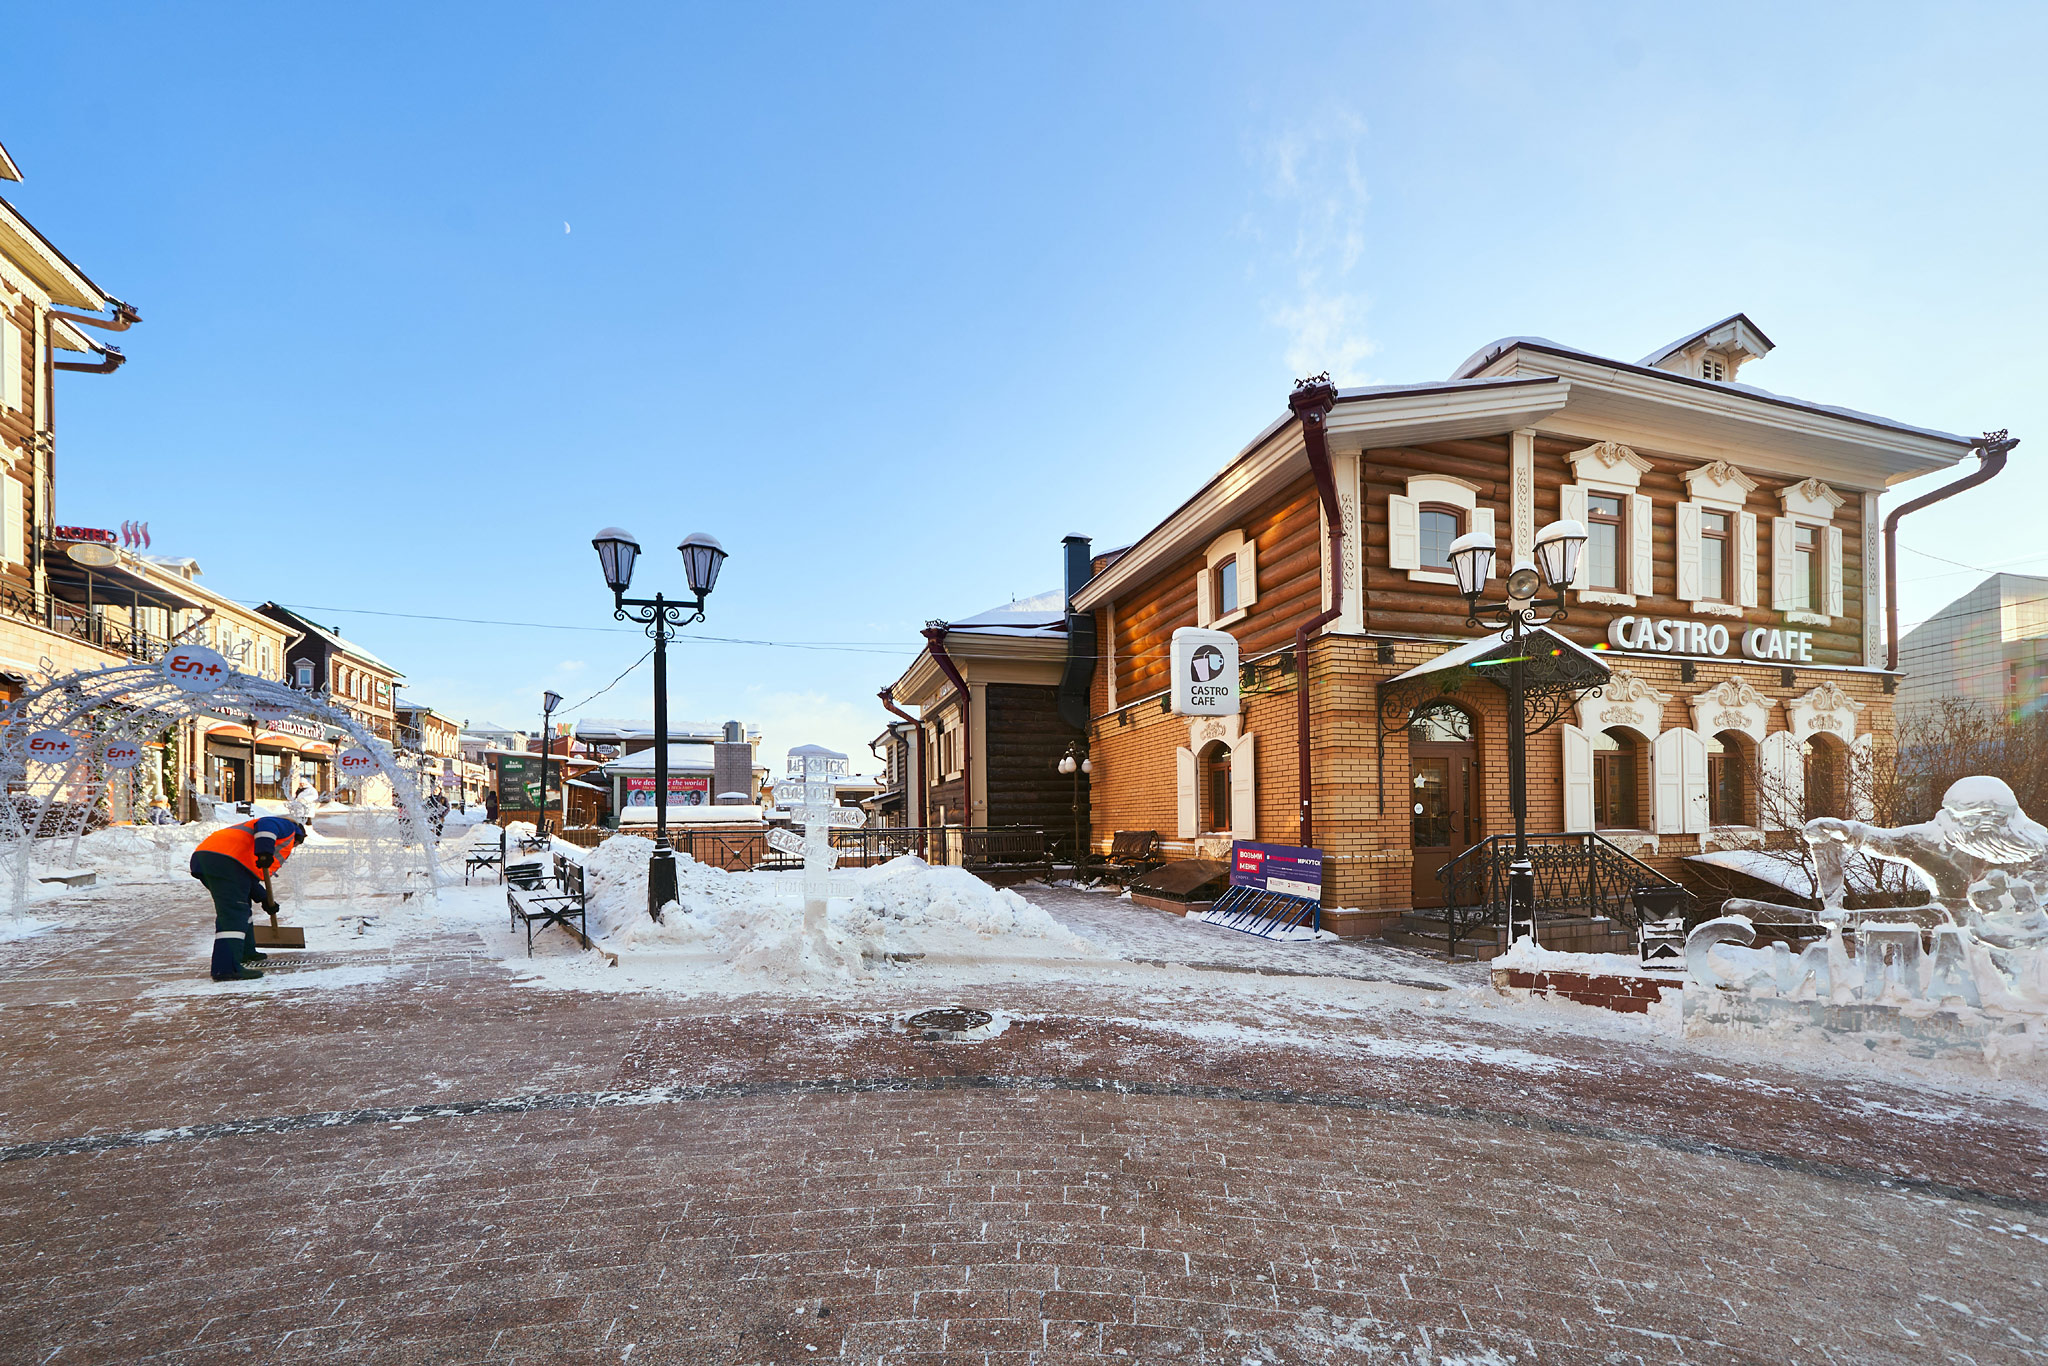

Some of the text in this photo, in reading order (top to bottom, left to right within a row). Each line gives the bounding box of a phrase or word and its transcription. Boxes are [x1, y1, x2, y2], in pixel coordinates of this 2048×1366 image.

[56, 525, 119, 543] HOTEL
[1608, 616, 1813, 662] CASTRO CAFE
[1191, 685, 1229, 696] CASTRO
[1191, 696, 1216, 706] CAFE
[788, 759, 846, 774] ИРКУТСК
[1240, 851, 1263, 860] ВОЗЬМИ
[1297, 858, 1321, 866] ИРКУТСК
